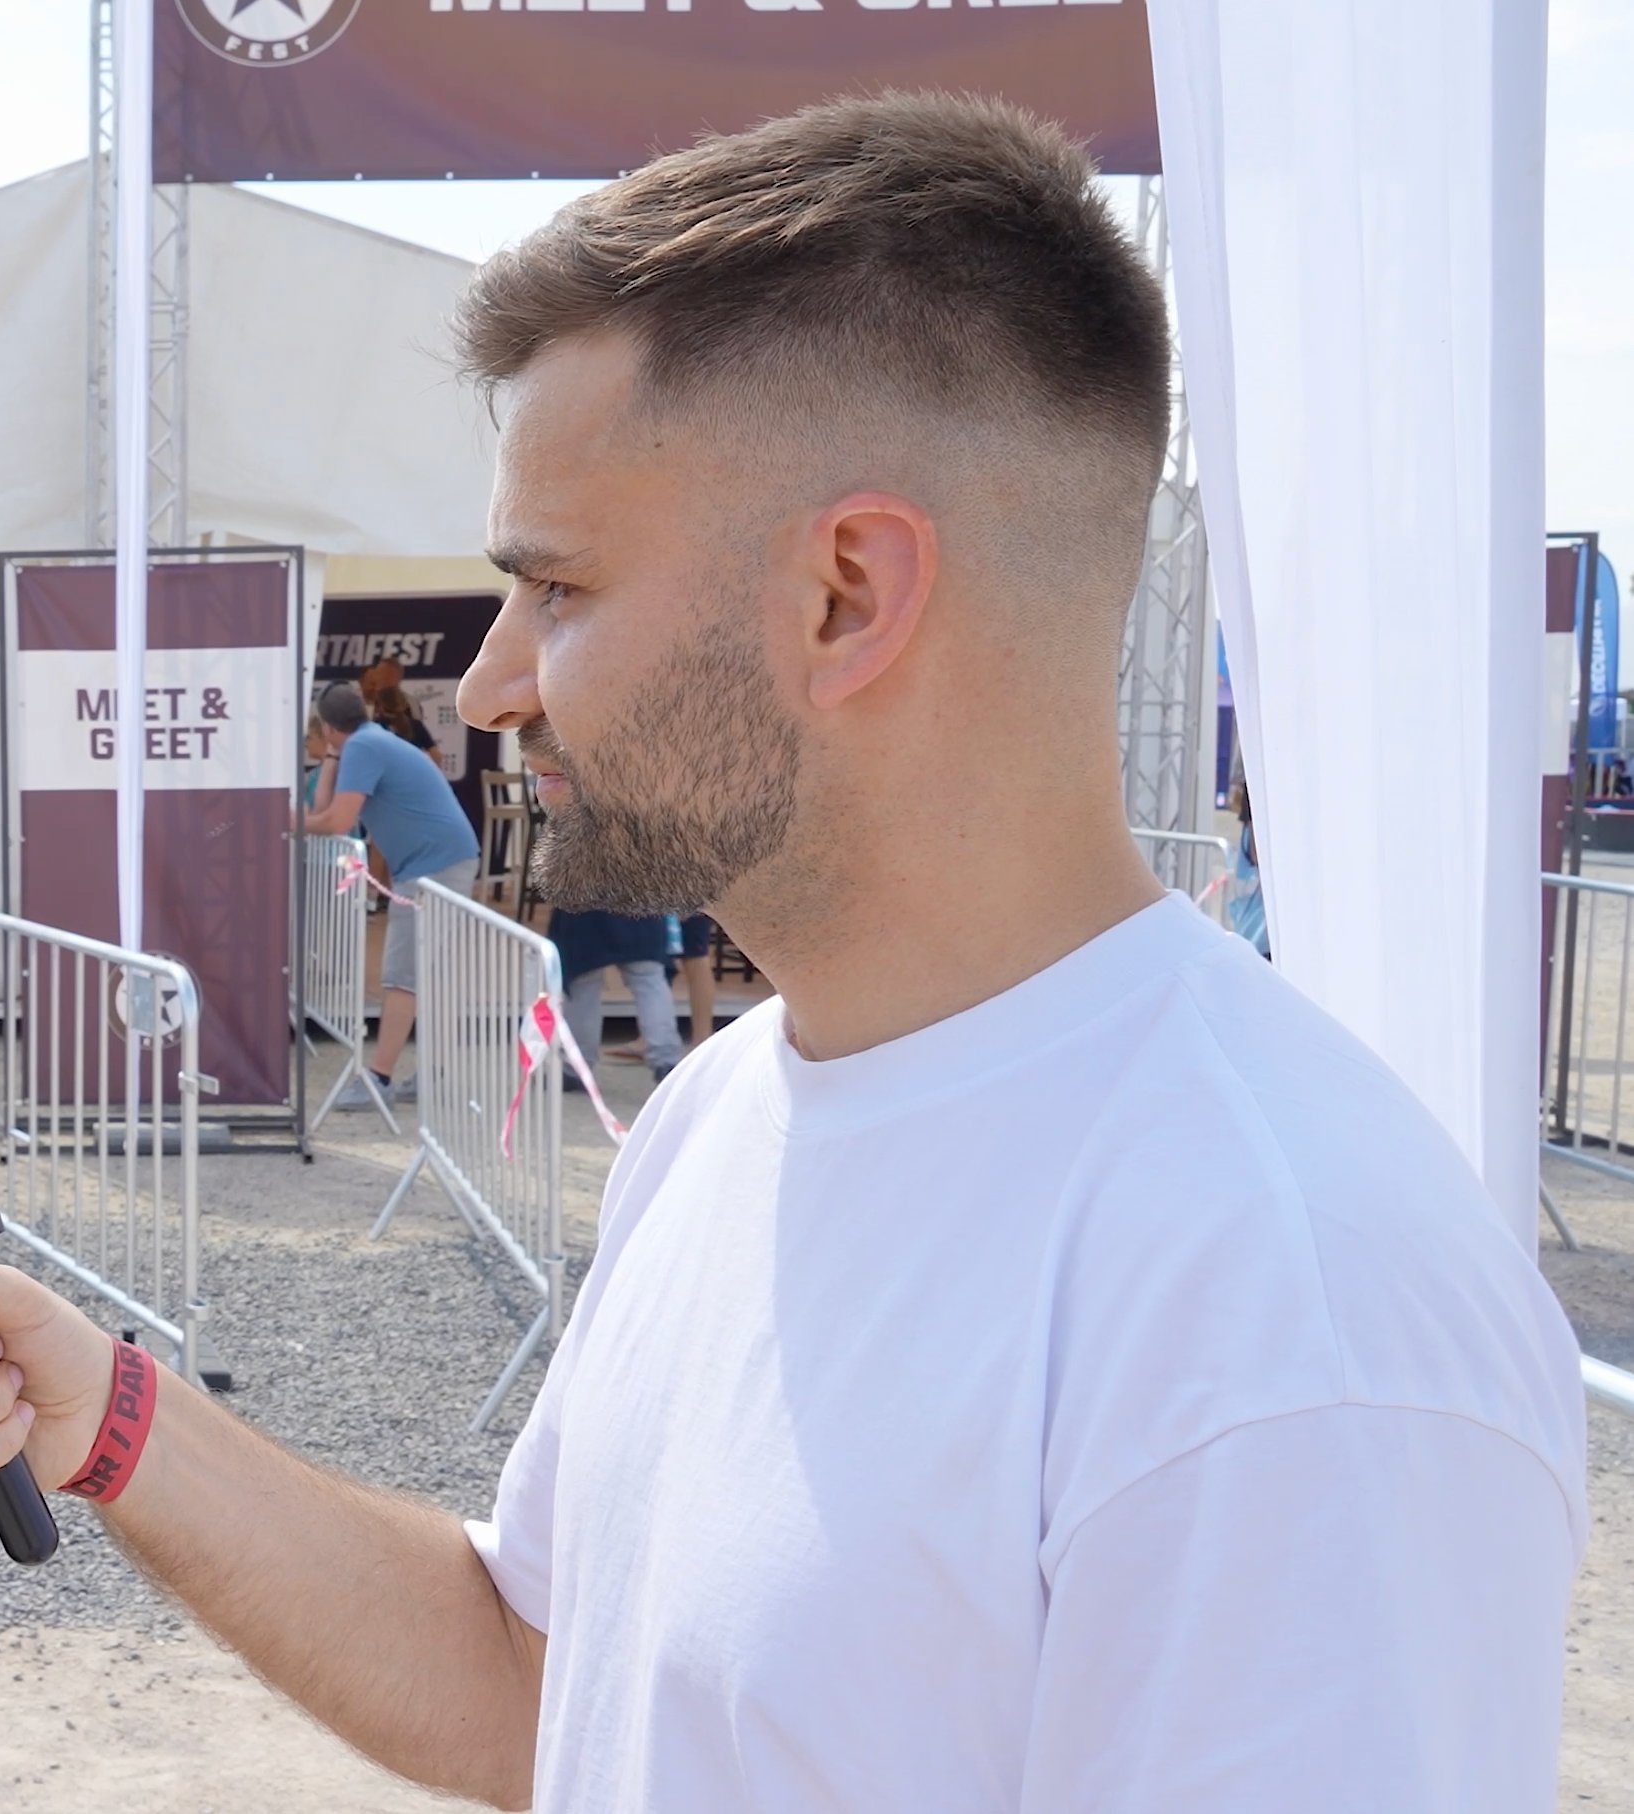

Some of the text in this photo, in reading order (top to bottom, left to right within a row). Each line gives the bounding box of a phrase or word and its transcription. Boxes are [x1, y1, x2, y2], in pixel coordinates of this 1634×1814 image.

[224, 35, 310, 60] FEST
[316, 632, 445, 667] RTAFEST
[76, 687, 232, 721] MET &
[90, 726, 219, 760] GEET
